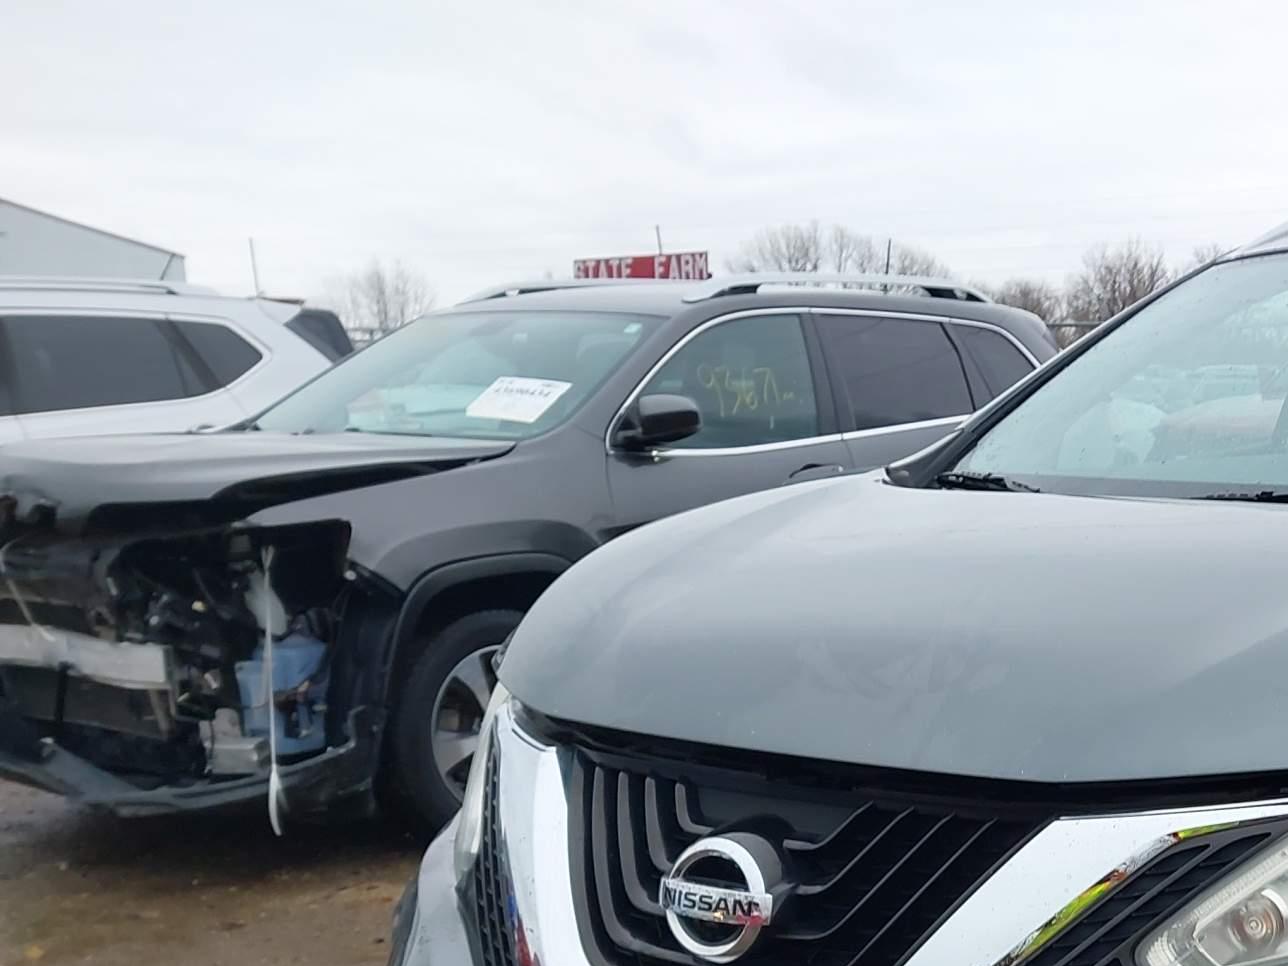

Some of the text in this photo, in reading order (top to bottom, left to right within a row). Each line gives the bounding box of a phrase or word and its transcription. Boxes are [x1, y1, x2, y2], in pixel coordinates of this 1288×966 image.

[574, 252, 708, 280] STATE FARM
[663, 886, 760, 917] NISSAN
